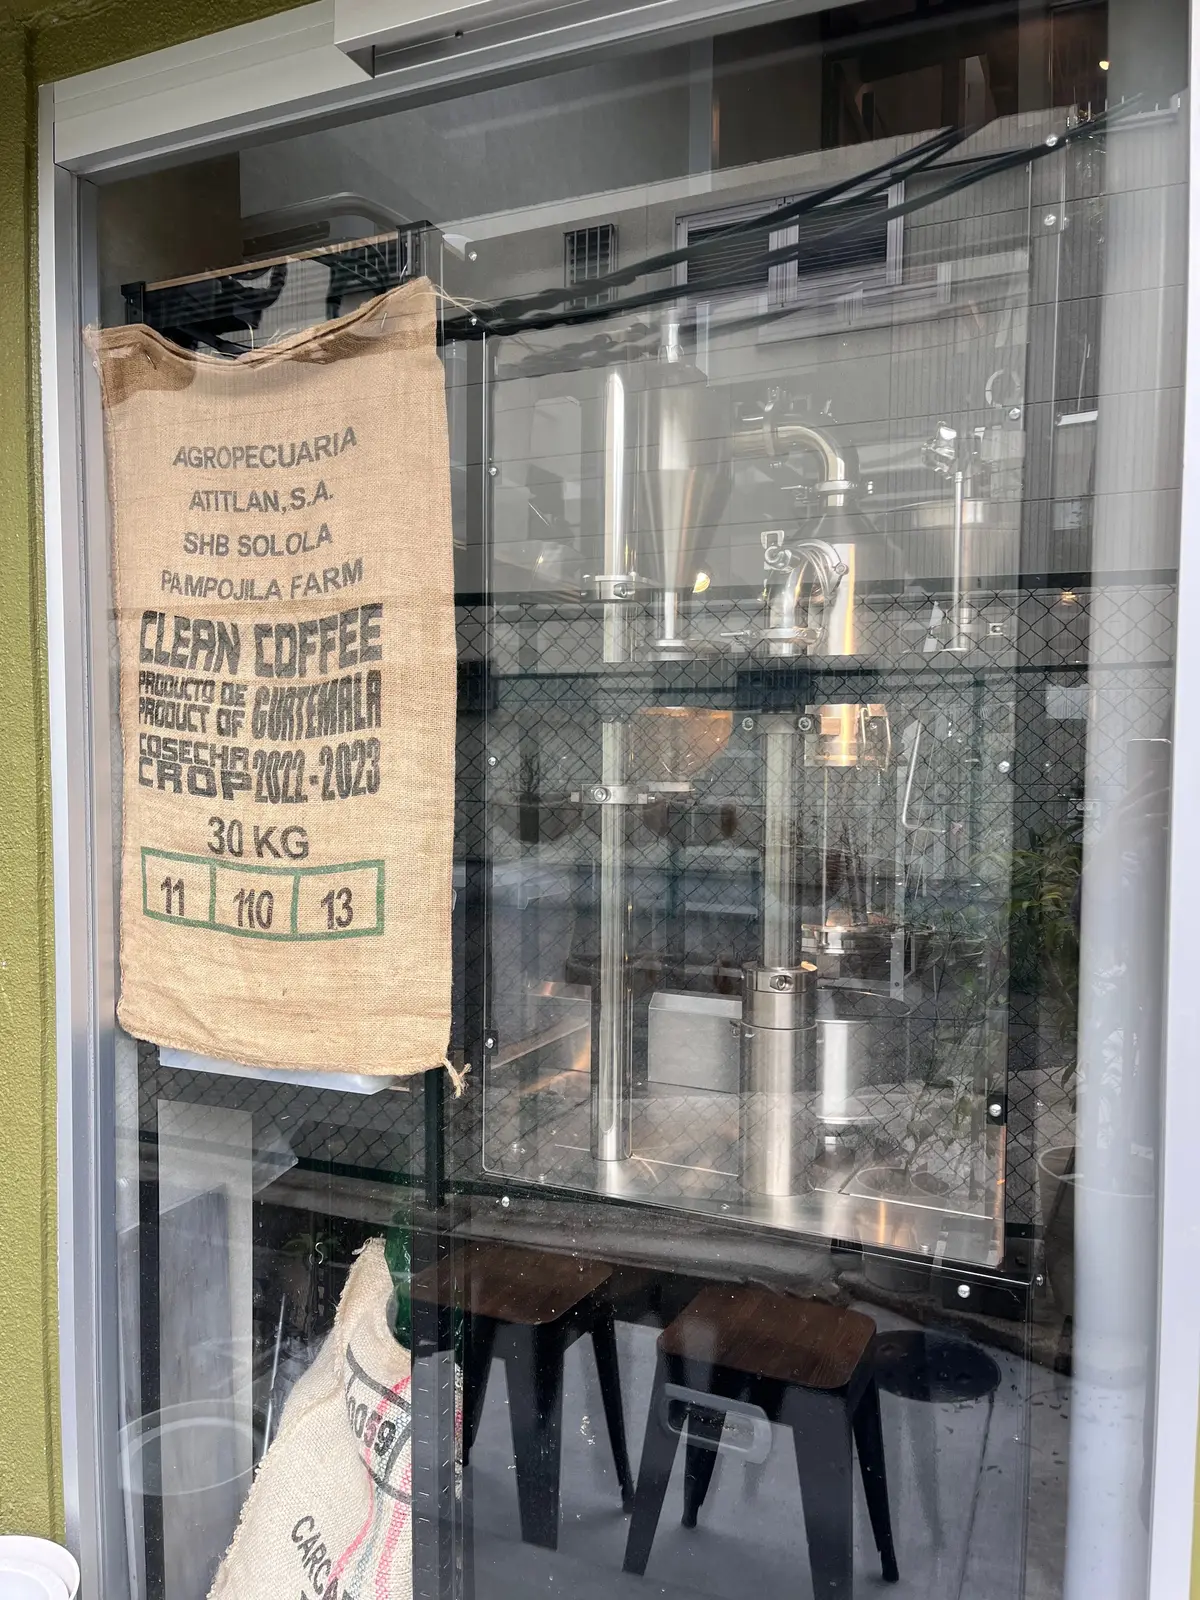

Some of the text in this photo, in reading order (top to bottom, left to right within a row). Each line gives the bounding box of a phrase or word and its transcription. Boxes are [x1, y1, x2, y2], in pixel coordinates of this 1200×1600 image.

[172, 426, 357, 469] AGROPECUARIA
[183, 522, 333, 557] SHB SOLOLA
[161, 557, 364, 601] PAMPOJILA FARM
[139, 602, 383, 679] CLEAN COFFEE
[138, 670, 248, 708] PRODUCTO DE
[251, 669, 382, 742] GUATEMALA
[138, 696, 247, 738] PRODUCT OF
[138, 732, 250, 771] COSECHA
[138, 755, 253, 801] CROP
[207, 816, 309, 860] 30 KG
[160, 876, 185, 916] 11
[233, 887, 274, 929] 110
[320, 886, 354, 930] 13
